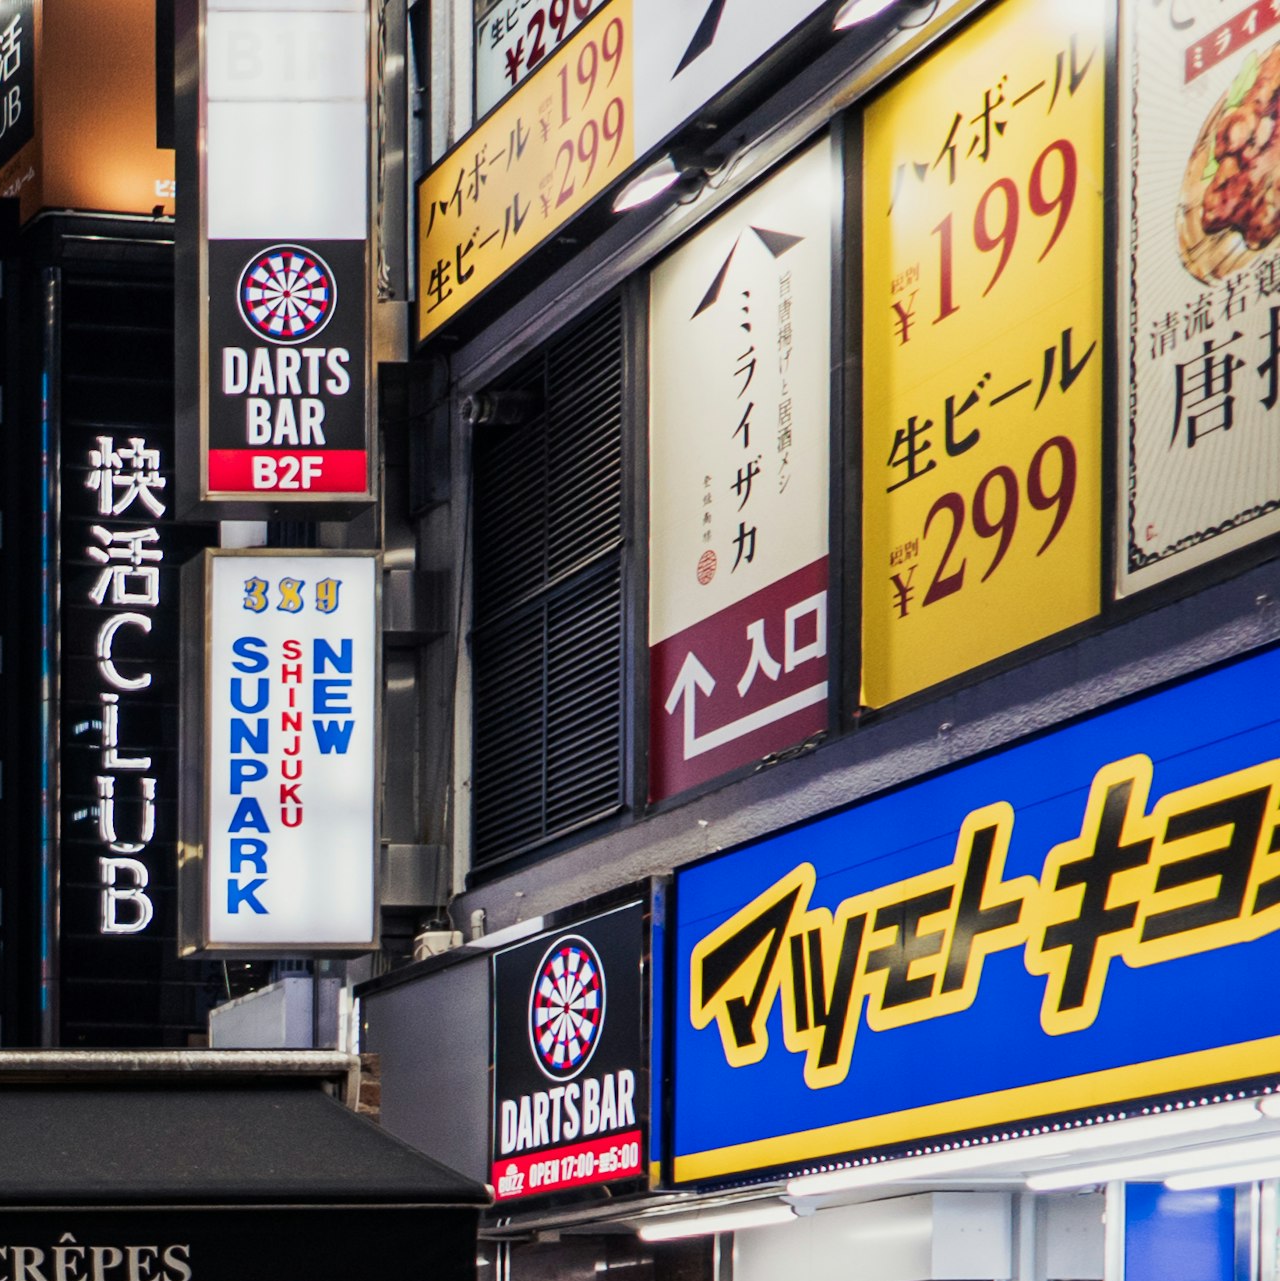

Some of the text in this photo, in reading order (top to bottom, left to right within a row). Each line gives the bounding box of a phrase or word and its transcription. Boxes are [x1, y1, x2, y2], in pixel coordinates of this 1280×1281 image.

[426, 118, 530, 239] ハイボール
[886, 32, 1097, 217] ハイボール
[427, 193, 531, 315] 生ビール
[222, 346, 351, 395] DARTS
[246, 397, 326, 446] BAR
[884, 327, 1097, 494] 生ビール
[251, 455, 324, 489] B2F
[729, 289, 763, 574] ミライザカ
[312, 638, 355, 754] NEW
[737, 589, 827, 697] 入口
[227, 636, 270, 914] SUNPARK
[279, 639, 304, 828] SHINJUKU
[501, 1069, 636, 1155] DARTS BAR
[529, 1160, 559, 1188] OPEN
